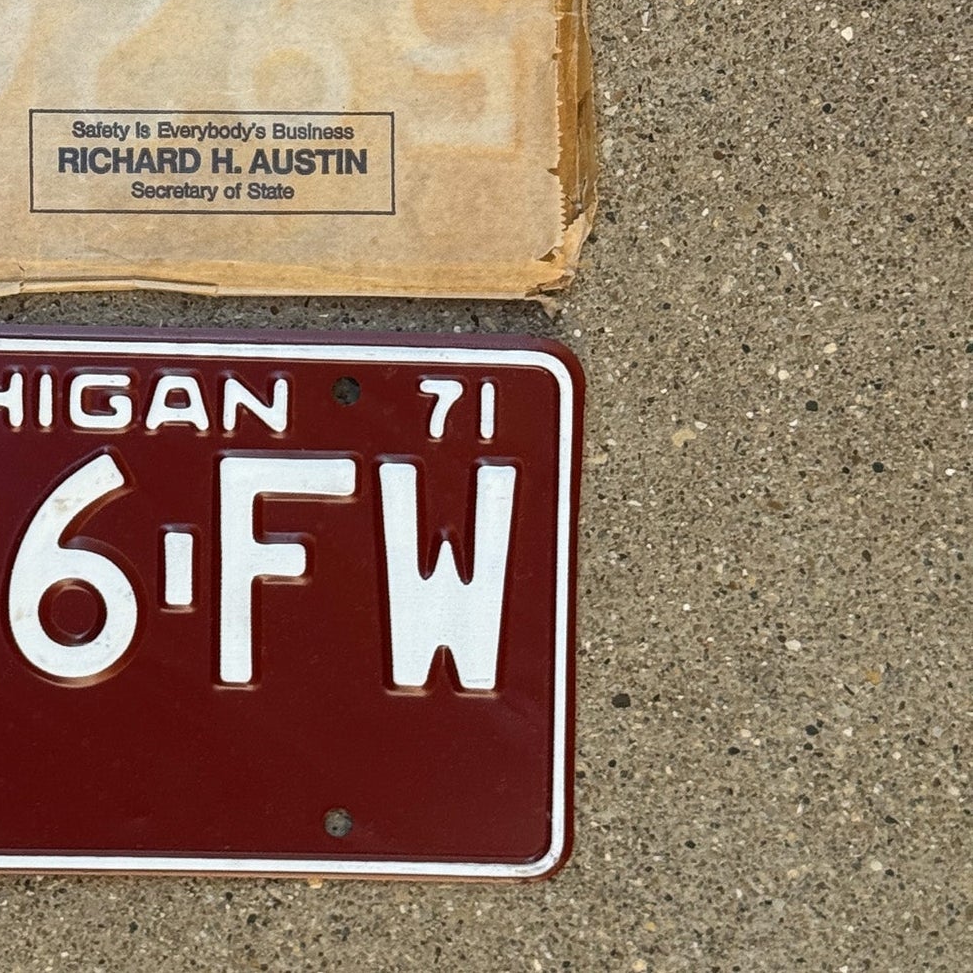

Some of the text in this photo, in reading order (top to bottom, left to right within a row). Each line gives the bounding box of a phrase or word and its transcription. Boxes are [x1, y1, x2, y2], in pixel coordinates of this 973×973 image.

[71, 120, 132, 143] Safety
[156, 120, 267, 143] Everybody's
[271, 121, 356, 141] Business
[57, 146, 369, 176] RICHARD H. AUSTIN
[131, 180, 296, 202] Secretary of State
[418, 377, 497, 441] 71
